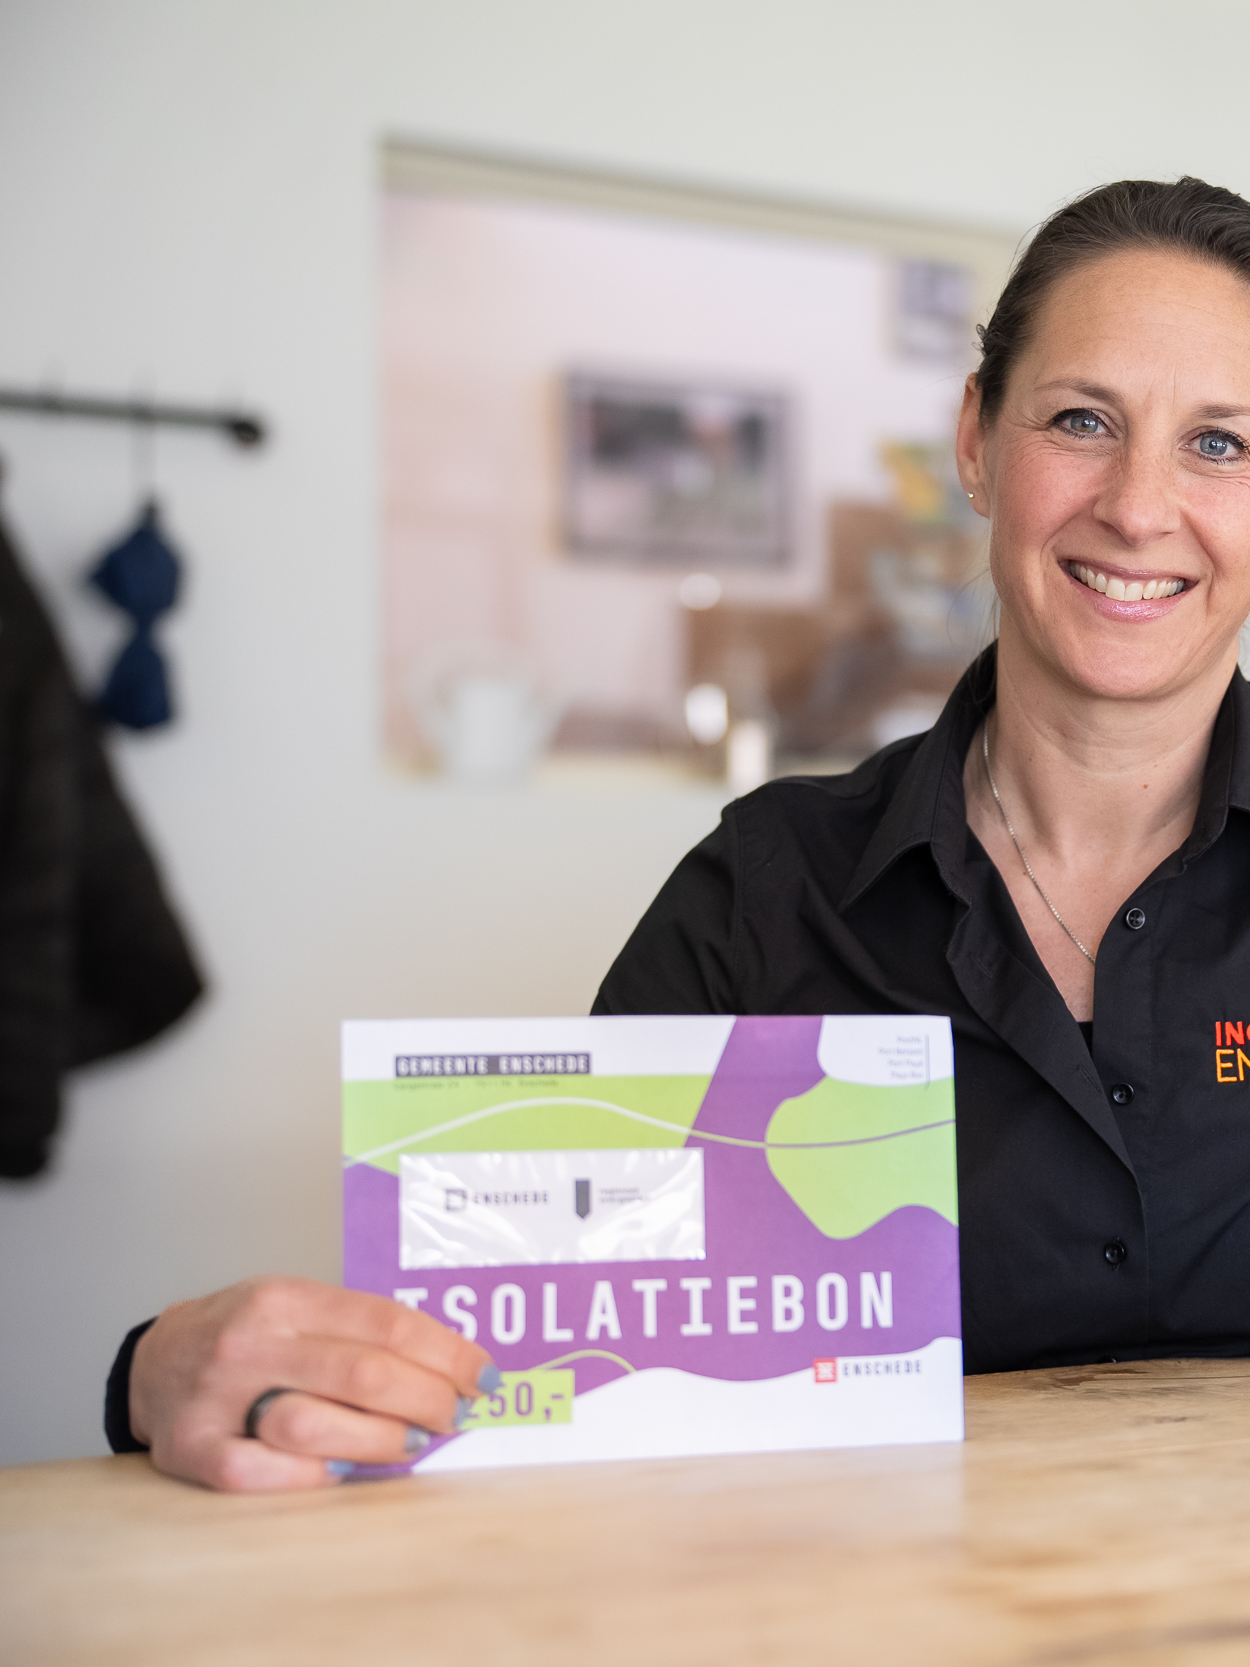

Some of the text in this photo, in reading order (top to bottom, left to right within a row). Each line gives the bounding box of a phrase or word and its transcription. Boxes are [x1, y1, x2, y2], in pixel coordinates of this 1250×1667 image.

[398, 1054, 590, 1077] GEMEENTE ENSCHEDE
[473, 1190, 549, 1206] ENSCHEDE
[842, 1360, 923, 1377] ENSCHEDE
